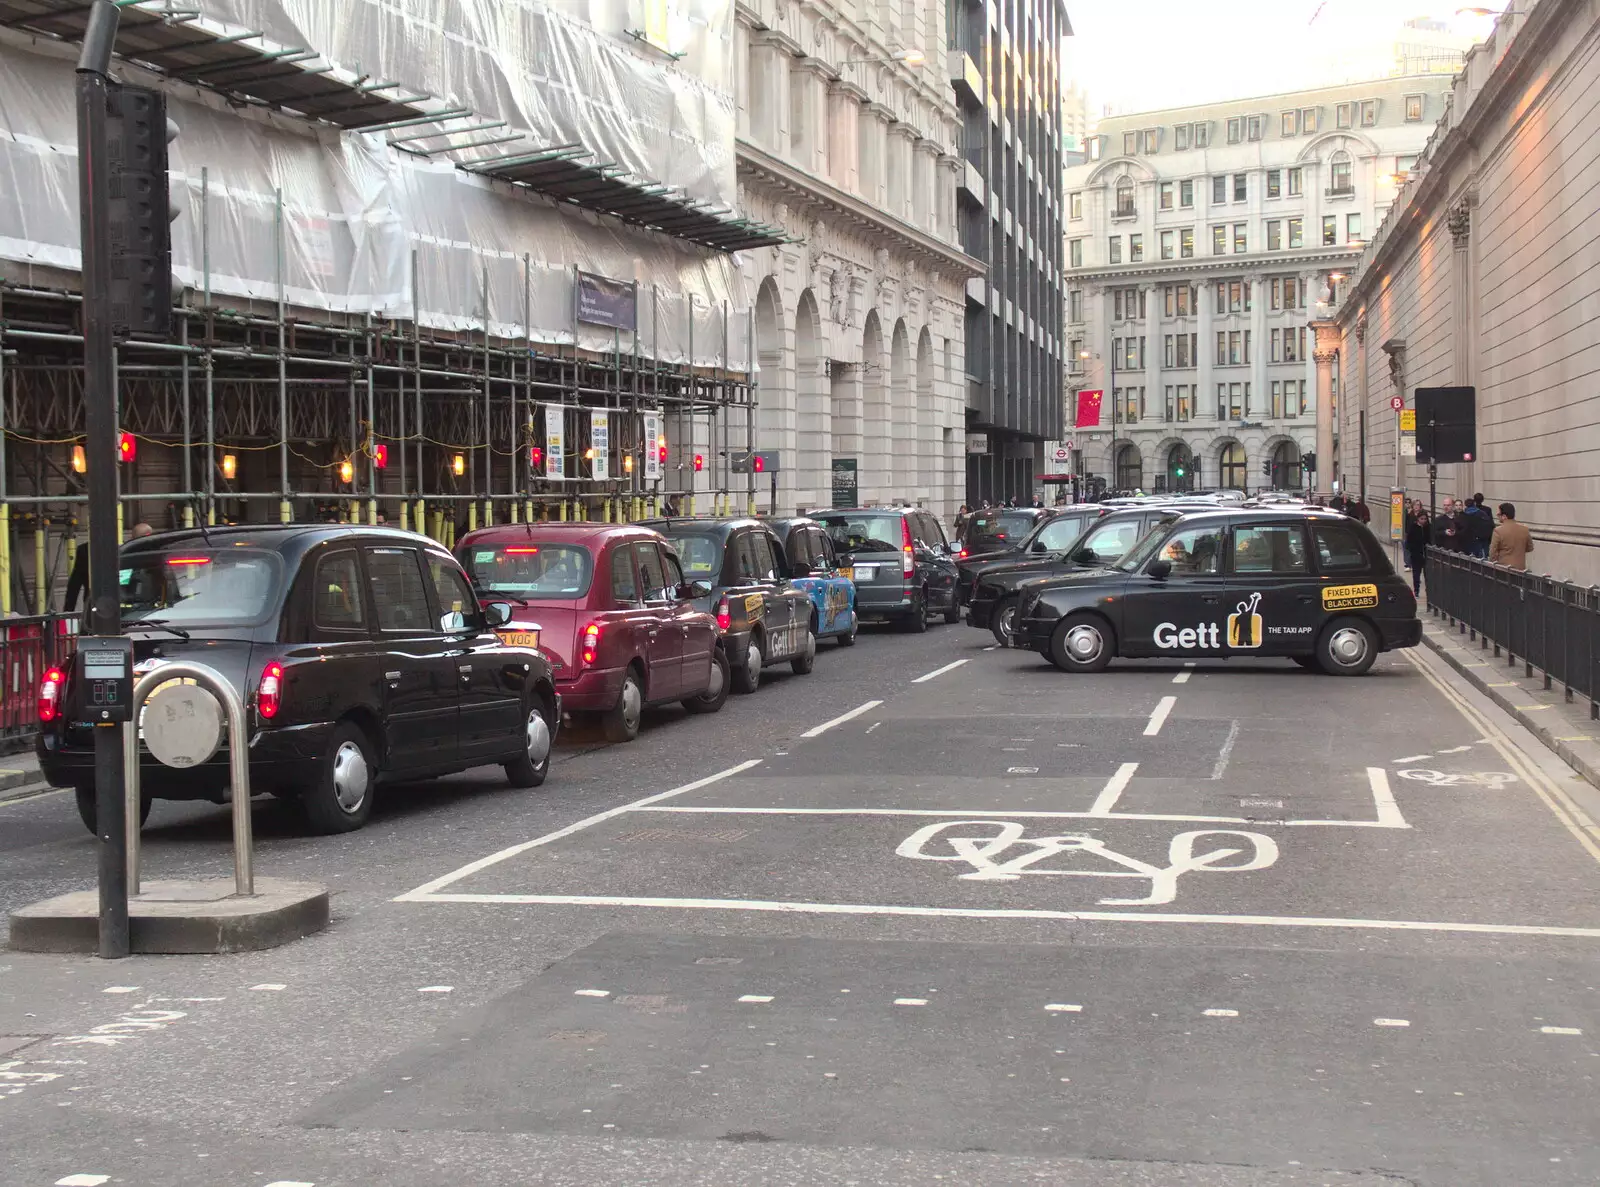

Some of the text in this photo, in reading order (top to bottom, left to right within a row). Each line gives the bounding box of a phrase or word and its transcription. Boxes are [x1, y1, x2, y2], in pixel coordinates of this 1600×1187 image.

[1394, 399, 1401, 408] B
[1327, 586, 1372, 597] FIXED FARE
[1328, 597, 1374, 608] BLACK CABS
[1153, 622, 1220, 649] Gett
[1298, 626, 1312, 634] APP
[510, 634, 531, 645] VOG
[771, 630, 788, 657] Gett
